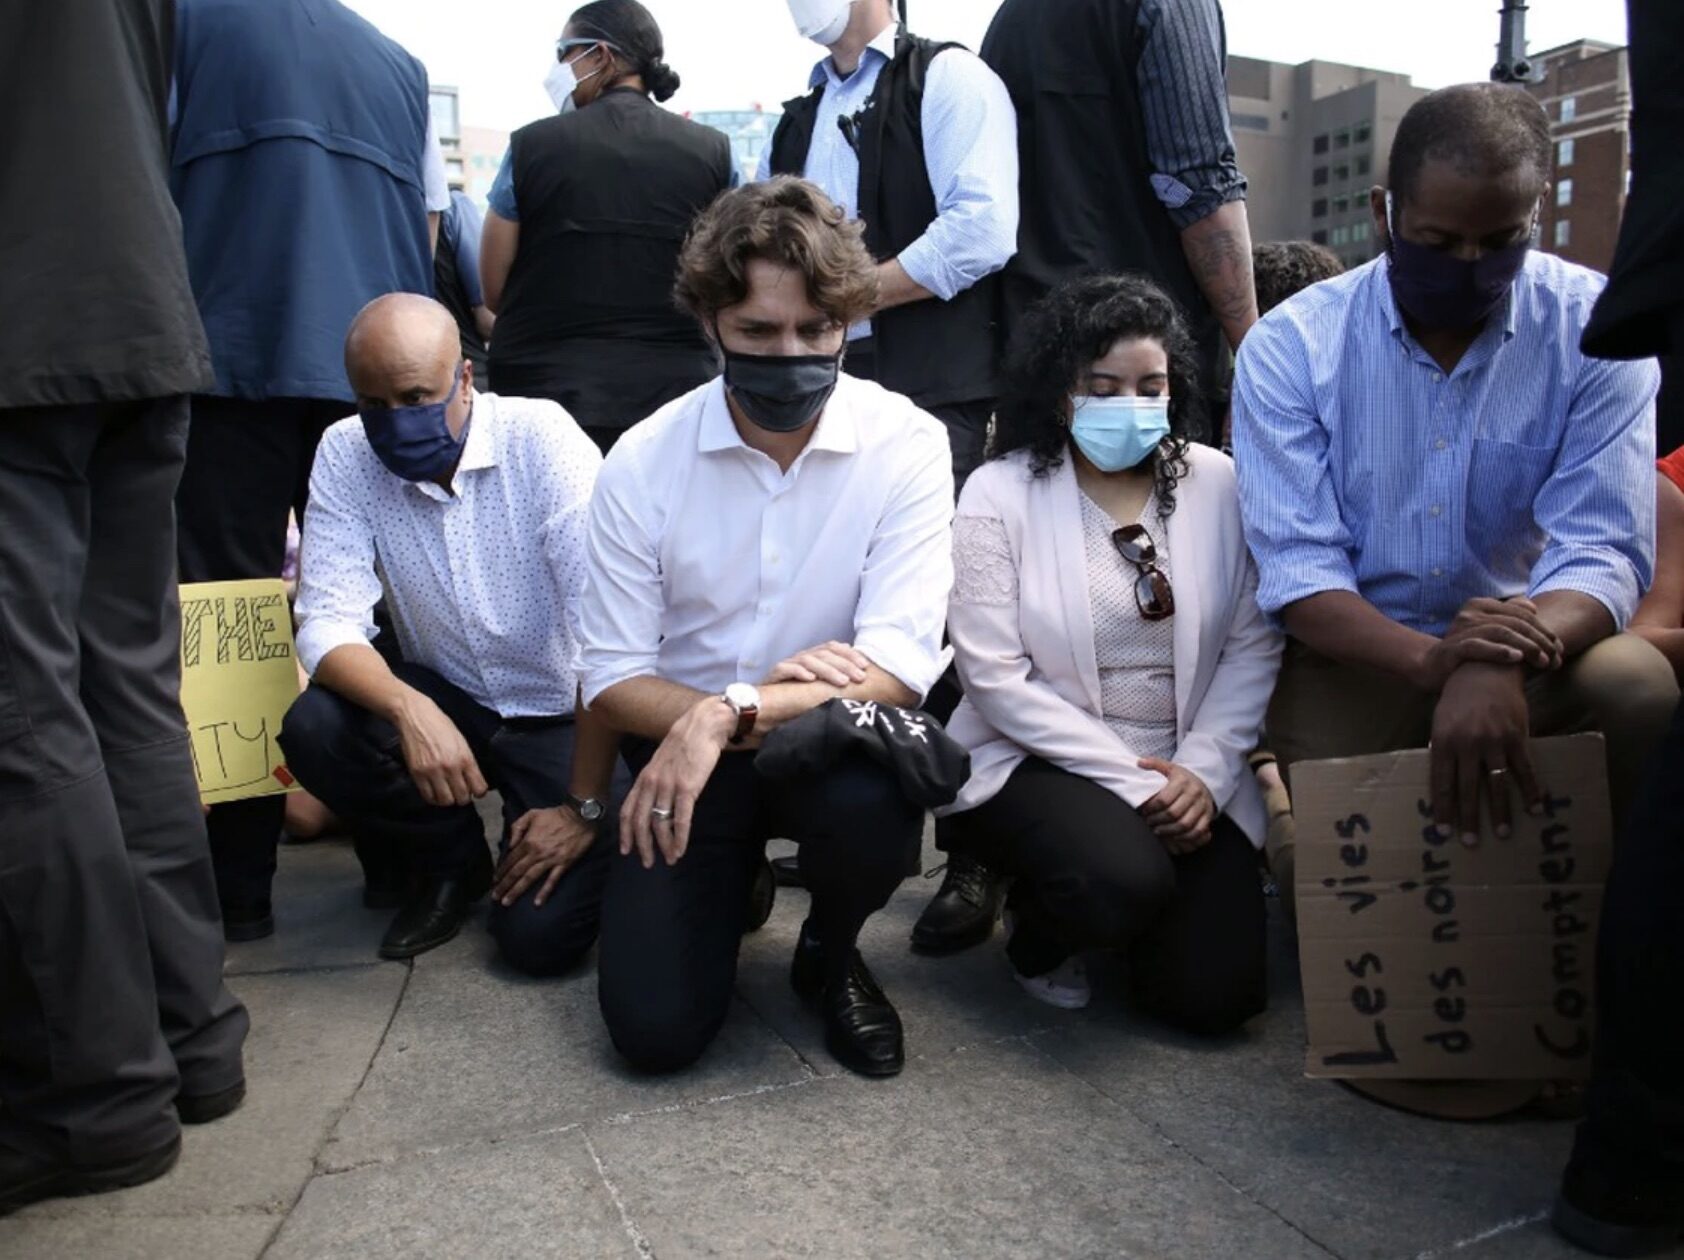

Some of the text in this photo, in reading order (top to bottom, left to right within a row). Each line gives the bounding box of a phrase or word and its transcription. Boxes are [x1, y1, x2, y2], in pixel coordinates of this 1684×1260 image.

[181, 594, 290, 667] THE
[1321, 812, 1398, 1066] Les vies
[1423, 966, 1472, 1054] des
[1534, 792, 1589, 1060] Comptent
